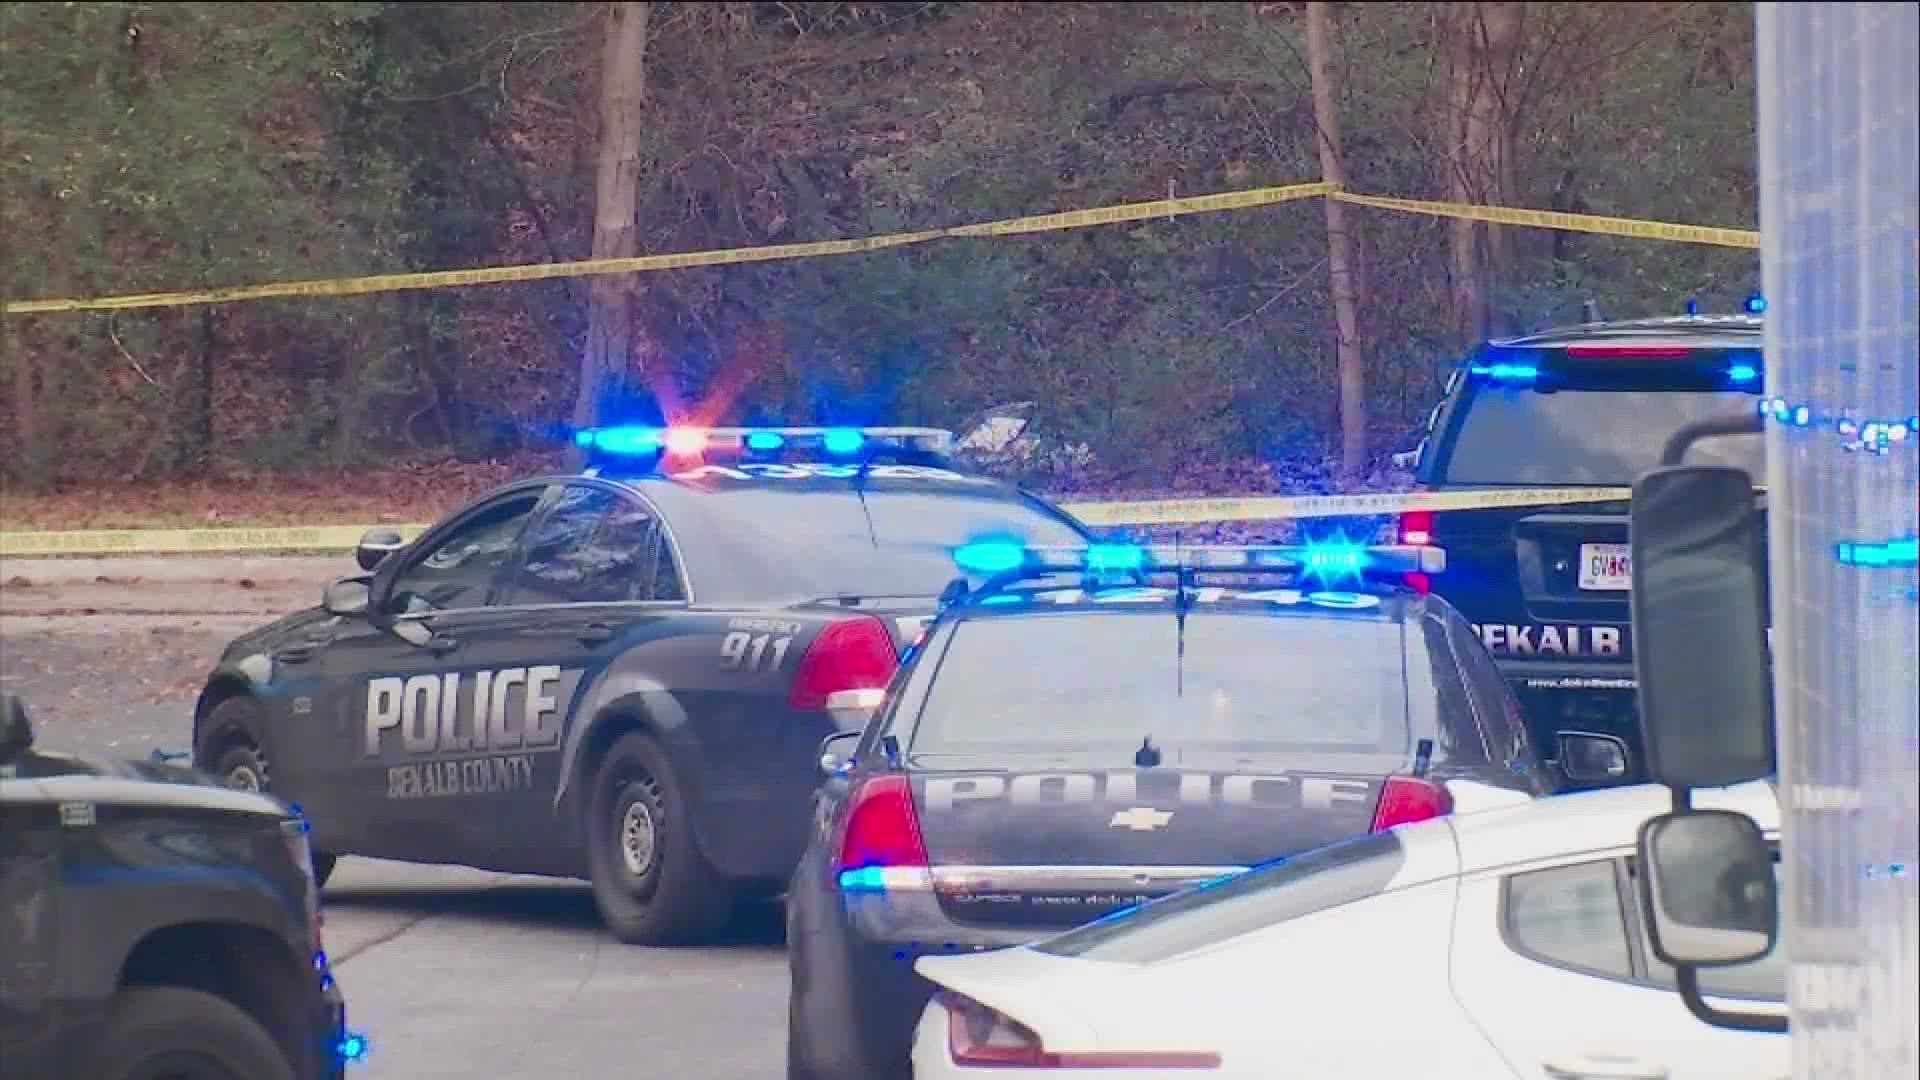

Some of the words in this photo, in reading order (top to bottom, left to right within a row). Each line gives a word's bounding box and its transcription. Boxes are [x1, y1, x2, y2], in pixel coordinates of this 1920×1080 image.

[721, 631, 792, 671] 911
[366, 664, 561, 756] POLICE
[462, 756, 535, 793] COUNTY
[925, 774, 1370, 808] POLICE
